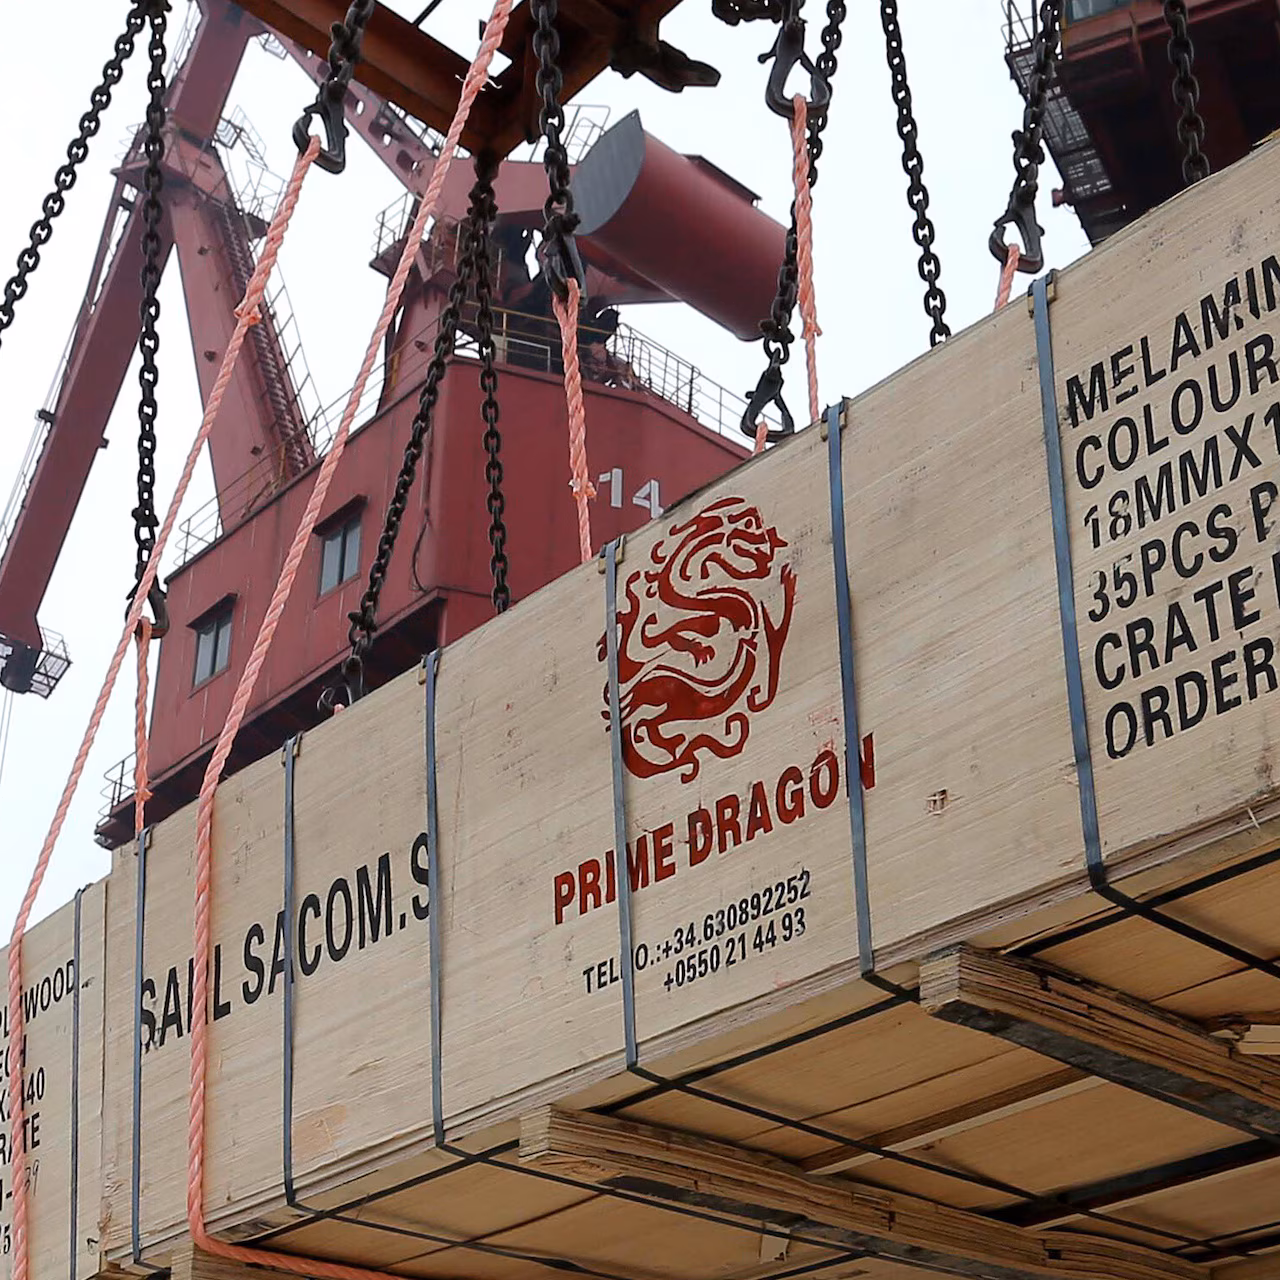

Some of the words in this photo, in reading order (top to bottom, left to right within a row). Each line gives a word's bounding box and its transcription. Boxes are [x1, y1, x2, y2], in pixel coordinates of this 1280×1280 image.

[1087, 503, 1239, 625] 35PCS
[1093, 565, 1264, 692] CRATE
[1104, 636, 1278, 761] ORDER
[242, 832, 431, 1005] SACOM.S
[554, 822, 677, 925] PRIME
[582, 868, 812, 995] TELO.:+34.630892252
[725, 932, 748, 969] 21
[753, 922, 777, 957] 44
[782, 907, 807, 944] 93
